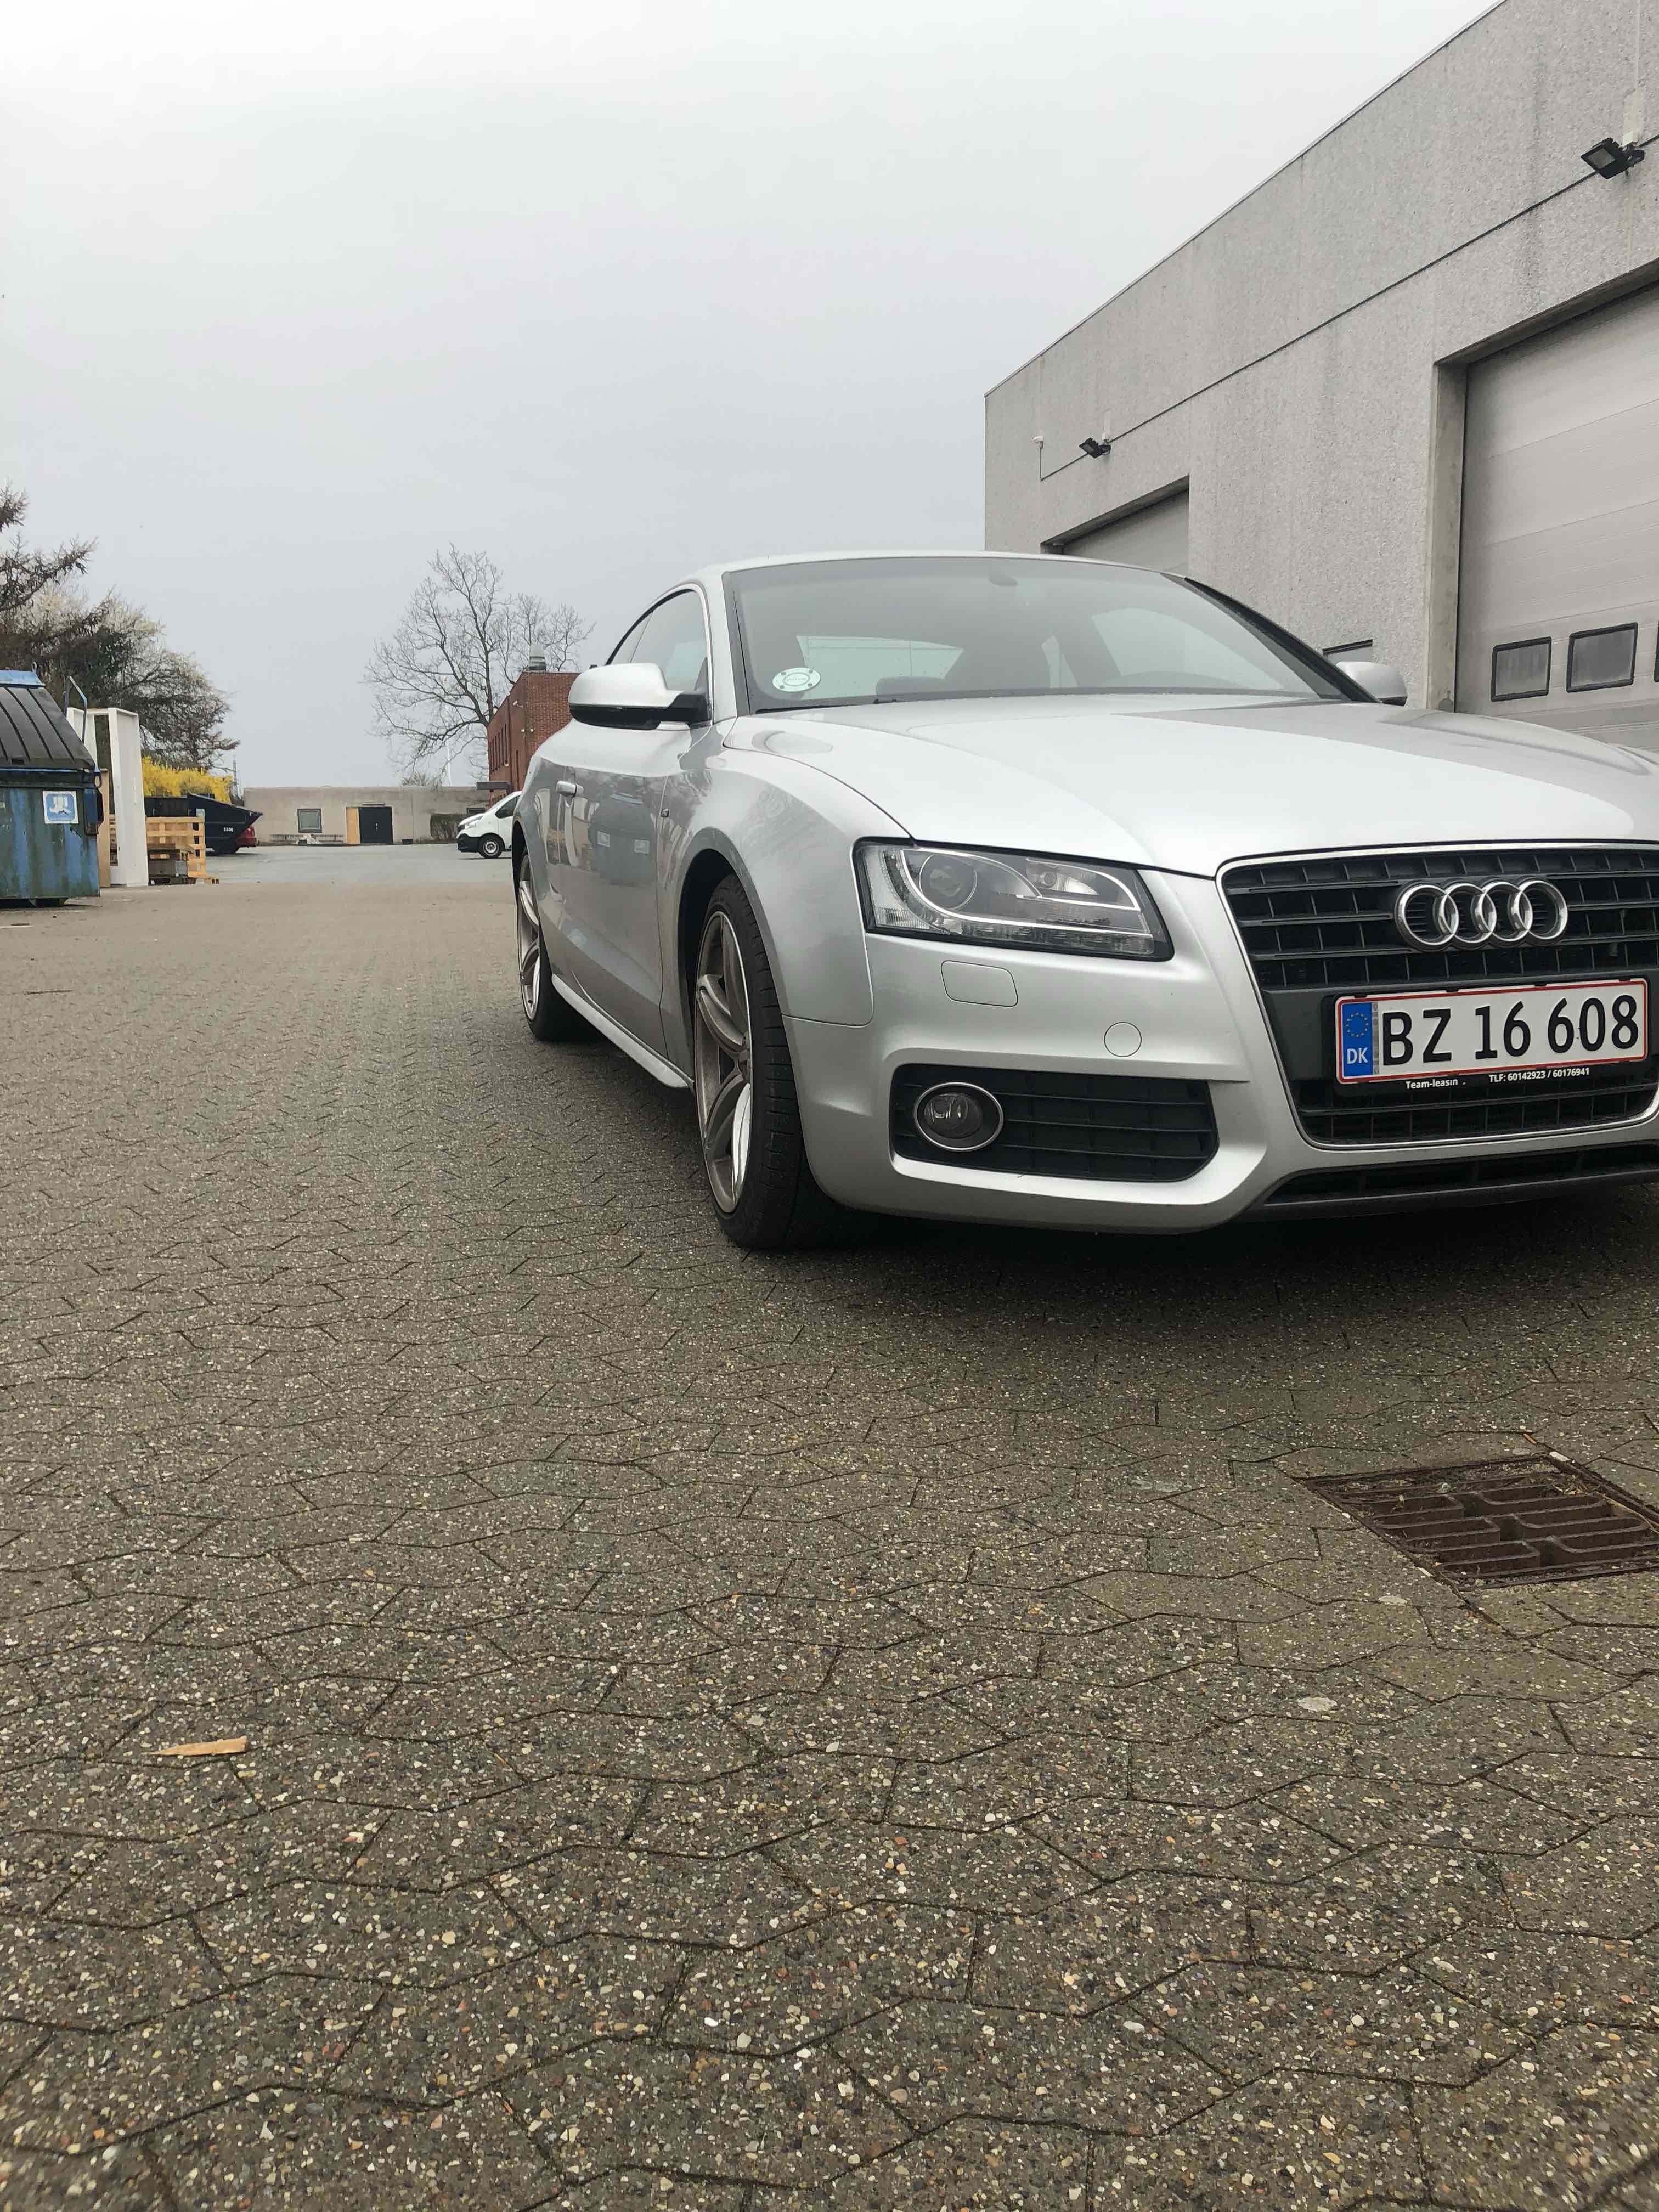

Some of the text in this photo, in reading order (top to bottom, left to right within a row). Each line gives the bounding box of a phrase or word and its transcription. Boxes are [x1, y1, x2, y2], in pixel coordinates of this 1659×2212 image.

[1383, 994, 1639, 1066] BZ 16 608
[1347, 1048, 1368, 1064] DK
[1488, 1067, 1589, 1082] TLF: 60142923 / 60176941
